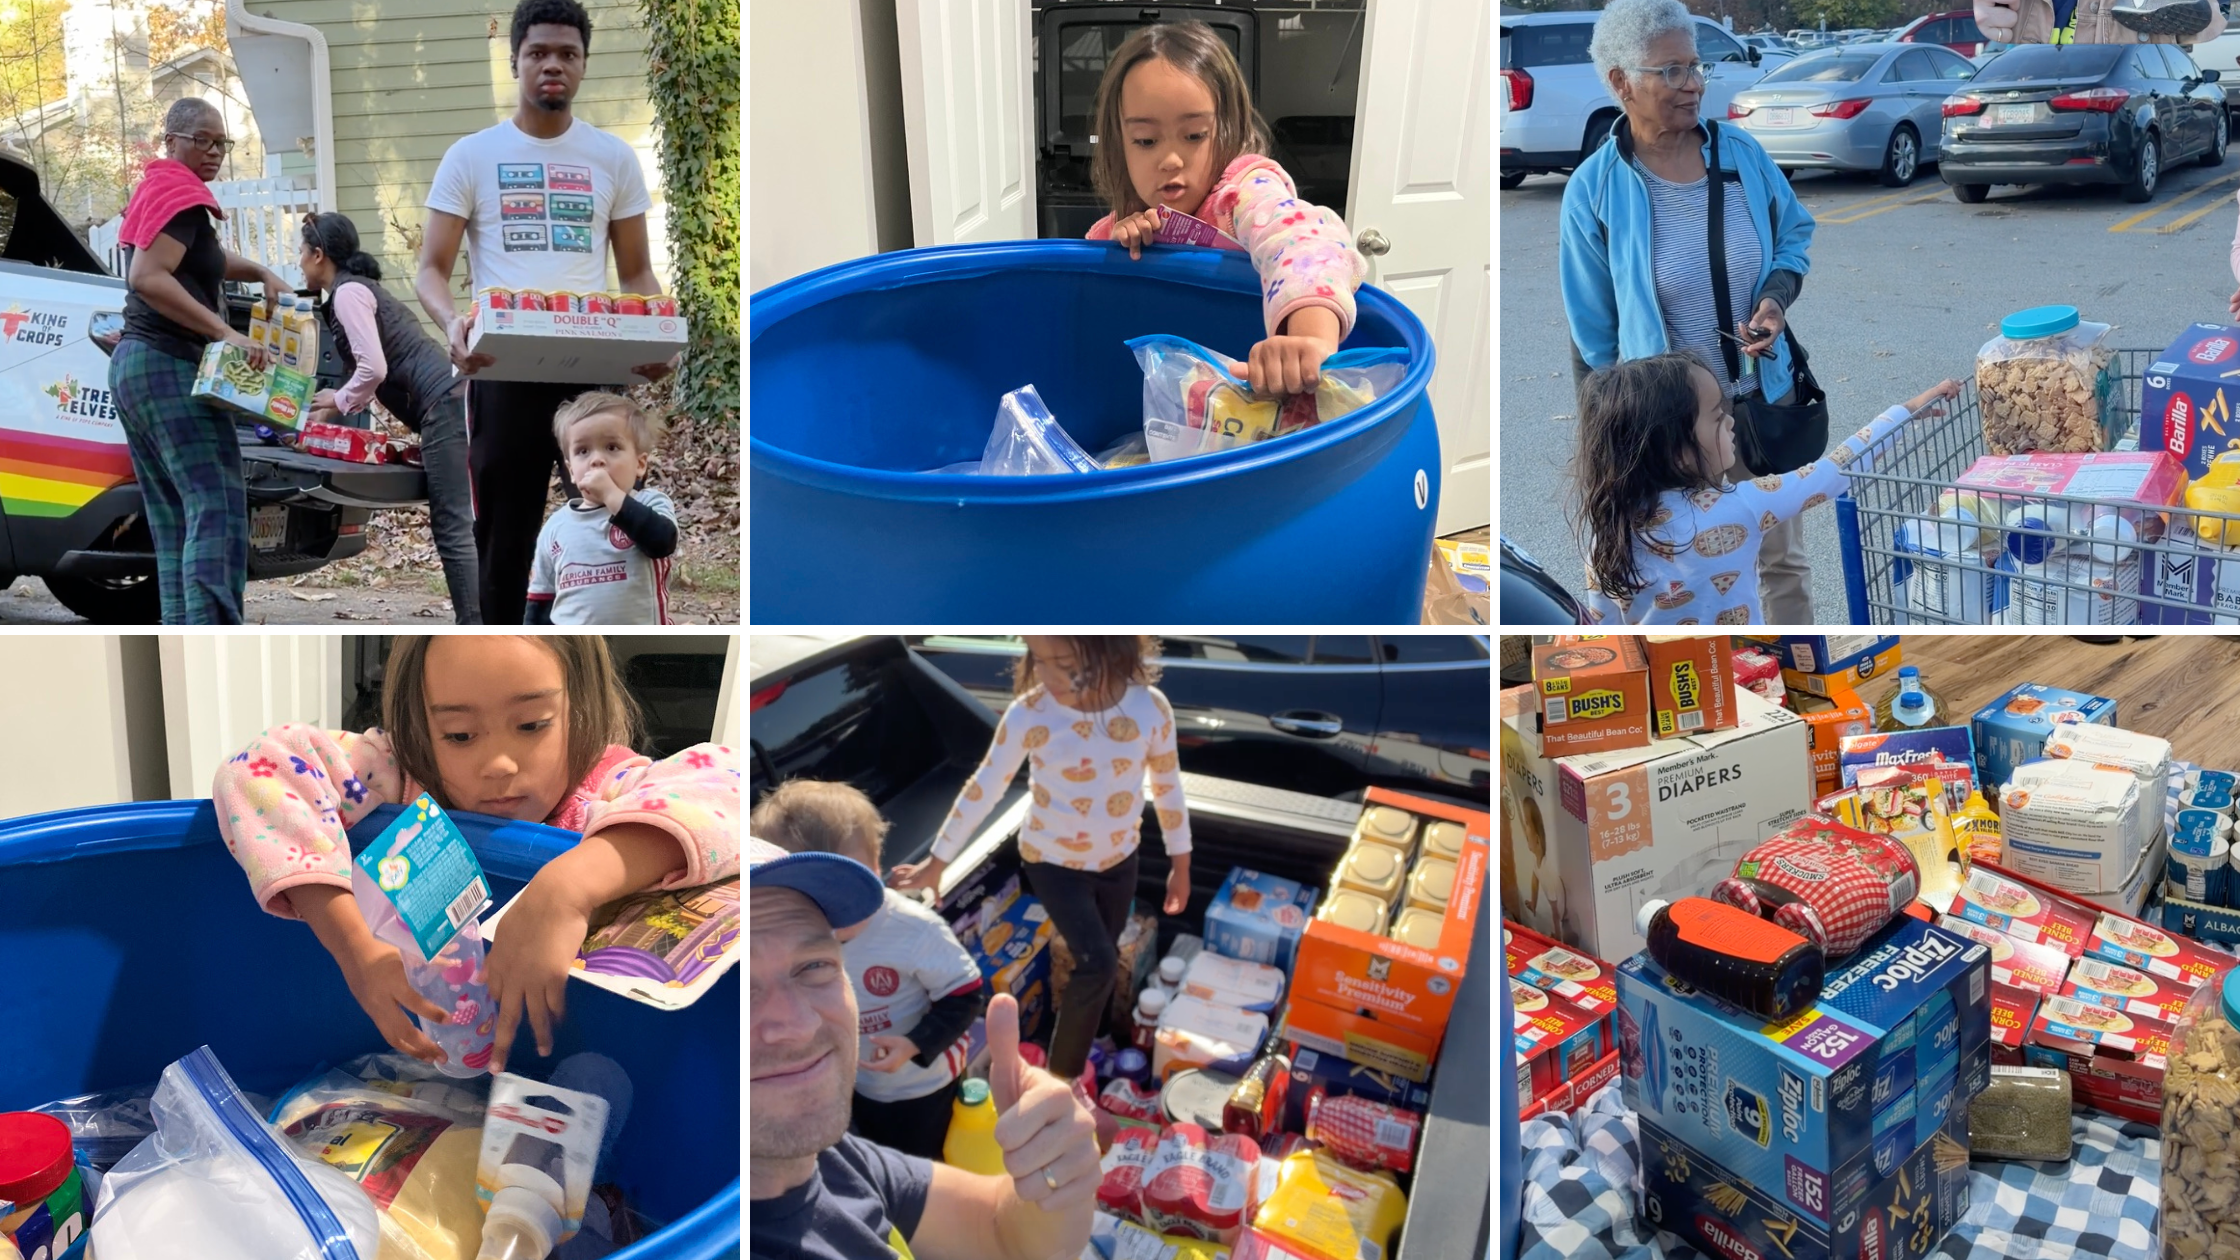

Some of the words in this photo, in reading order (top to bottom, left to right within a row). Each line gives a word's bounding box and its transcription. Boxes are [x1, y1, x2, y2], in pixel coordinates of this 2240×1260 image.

[31, 312, 68, 328] KING
[553, 315, 599, 326] DOUBLE
[16, 329, 64, 346] CROPS
[555, 329, 578, 337] PINK
[579, 330, 617, 338] SALMON
[2195, 338, 2231, 362] Barilla
[2147, 376, 2166, 388] 6
[81, 387, 115, 405] TRE
[70, 400, 117, 420] ELVES
[2170, 399, 2188, 454] Barilla
[560, 573, 621, 589] INSURANCE
[595, 565, 626, 577] FAMILY
[1710, 656, 1719, 674] Bean
[1546, 681, 1552, 691] 8
[1675, 662, 1696, 708] BUSH'S
[1712, 674, 1720, 709] Beautiful
[1572, 693, 1622, 715] BUSH'S
[1715, 710, 1723, 726] That
[1765, 709, 1795, 723] 222
[1546, 734, 1565, 743] That
[1567, 729, 1604, 742] Beautiful
[1606, 727, 1627, 737] Bean
[1506, 753, 1544, 796] DIAPERS
[1657, 758, 1695, 776] Member's
[1657, 766, 1704, 786] PREMIUM
[1658, 764, 1742, 802] DIAPERS
[1606, 781, 1632, 820] 3
[1686, 812, 1715, 826] POCKETED
[1715, 802, 1747, 817] WAISTBAND
[1767, 814, 1794, 827] STRETCHY
[1794, 809, 1807, 818] SIDES
[1778, 808, 1795, 818] SUPER
[1600, 825, 1626, 839] 16-28
[1627, 822, 1641, 833] lbs
[1980, 819, 2000, 829] MOR
[1602, 835, 1625, 849] (7-13
[1626, 830, 1640, 842] kg)
[1604, 881, 1622, 890] ULTRA
[1622, 870, 1654, 884] ABSORBENT
[1612, 872, 1630, 882] PLUSH
[1978, 912, 1985, 920] 3
[2039, 924, 2080, 945] CORNED
[2051, 922, 2073, 934] BEEF
[1819, 944, 1900, 999] FREEZER
[1872, 936, 1956, 992] Ziploc
[2025, 966, 2048, 977] BEEF
[1335, 970, 1416, 1004] Sensitivity
[2013, 968, 2055, 987] CORNED
[1338, 983, 1405, 1012] Premium
[1585, 986, 1617, 1004] CORNED
[1530, 1017, 1564, 1036] CORNED
[1544, 1016, 1565, 1027] BEEF
[1781, 1016, 1811, 1036] SAVE
[1800, 1023, 1839, 1051] GALLON
[1811, 1030, 1860, 1059] 152
[1575, 1063, 1615, 1096] CORNED
[1699, 1047, 1709, 1126] PROTECTION
[1832, 1064, 1862, 1093] Ziploc
[1708, 1046, 1721, 1141] PREMIUM
[1744, 1106, 1762, 1128] 9
[1777, 1072, 1803, 1143] Ziploc
[1163, 1151, 1196, 1164] EAGLE
[1200, 1154, 1231, 1180] BRAND
[1790, 1164, 1798, 1198] GALLON
[1796, 1166, 1804, 1202] FREEZER
[1804, 1172, 1823, 1212] 152
